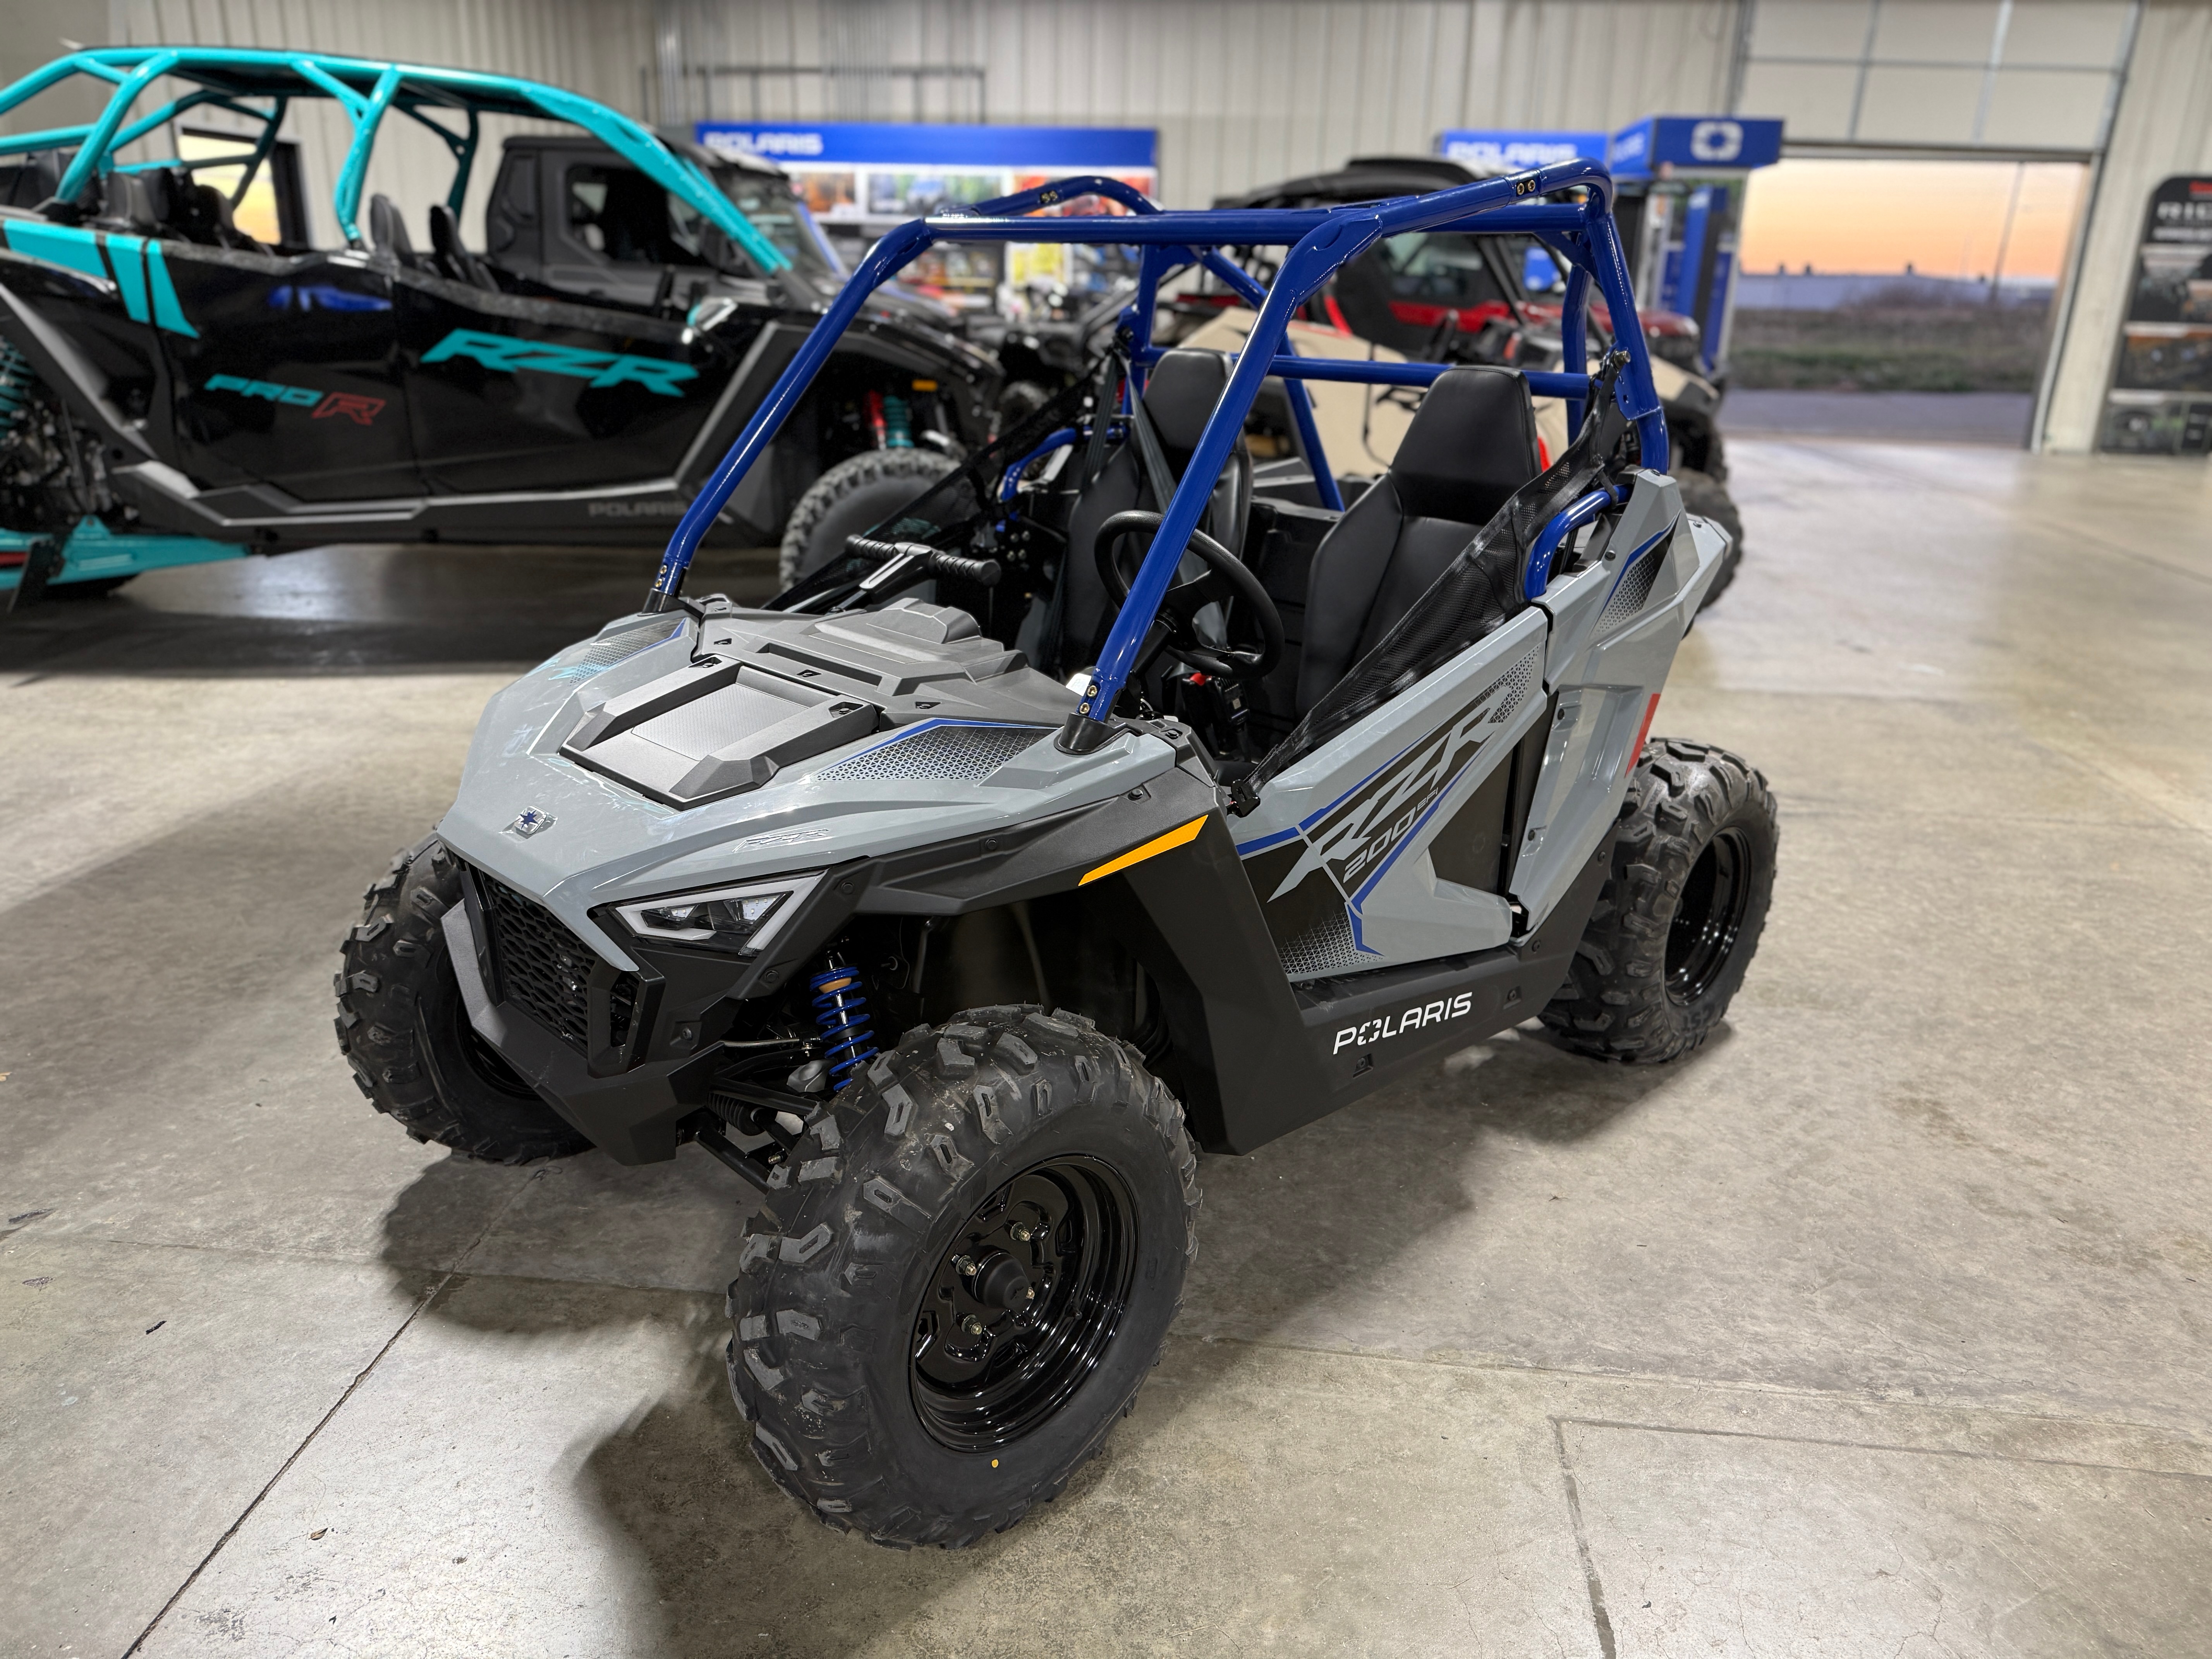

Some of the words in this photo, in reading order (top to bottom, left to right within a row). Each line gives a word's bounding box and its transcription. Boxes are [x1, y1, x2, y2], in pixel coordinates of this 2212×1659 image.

[203, 373, 324, 407] PRO
[420, 328, 699, 397] RZR
[1266, 685, 1512, 903] RZR
[1343, 807, 1416, 883] 200
[1417, 787, 1438, 811] EFI
[1333, 992, 1472, 1055] POLARIS
